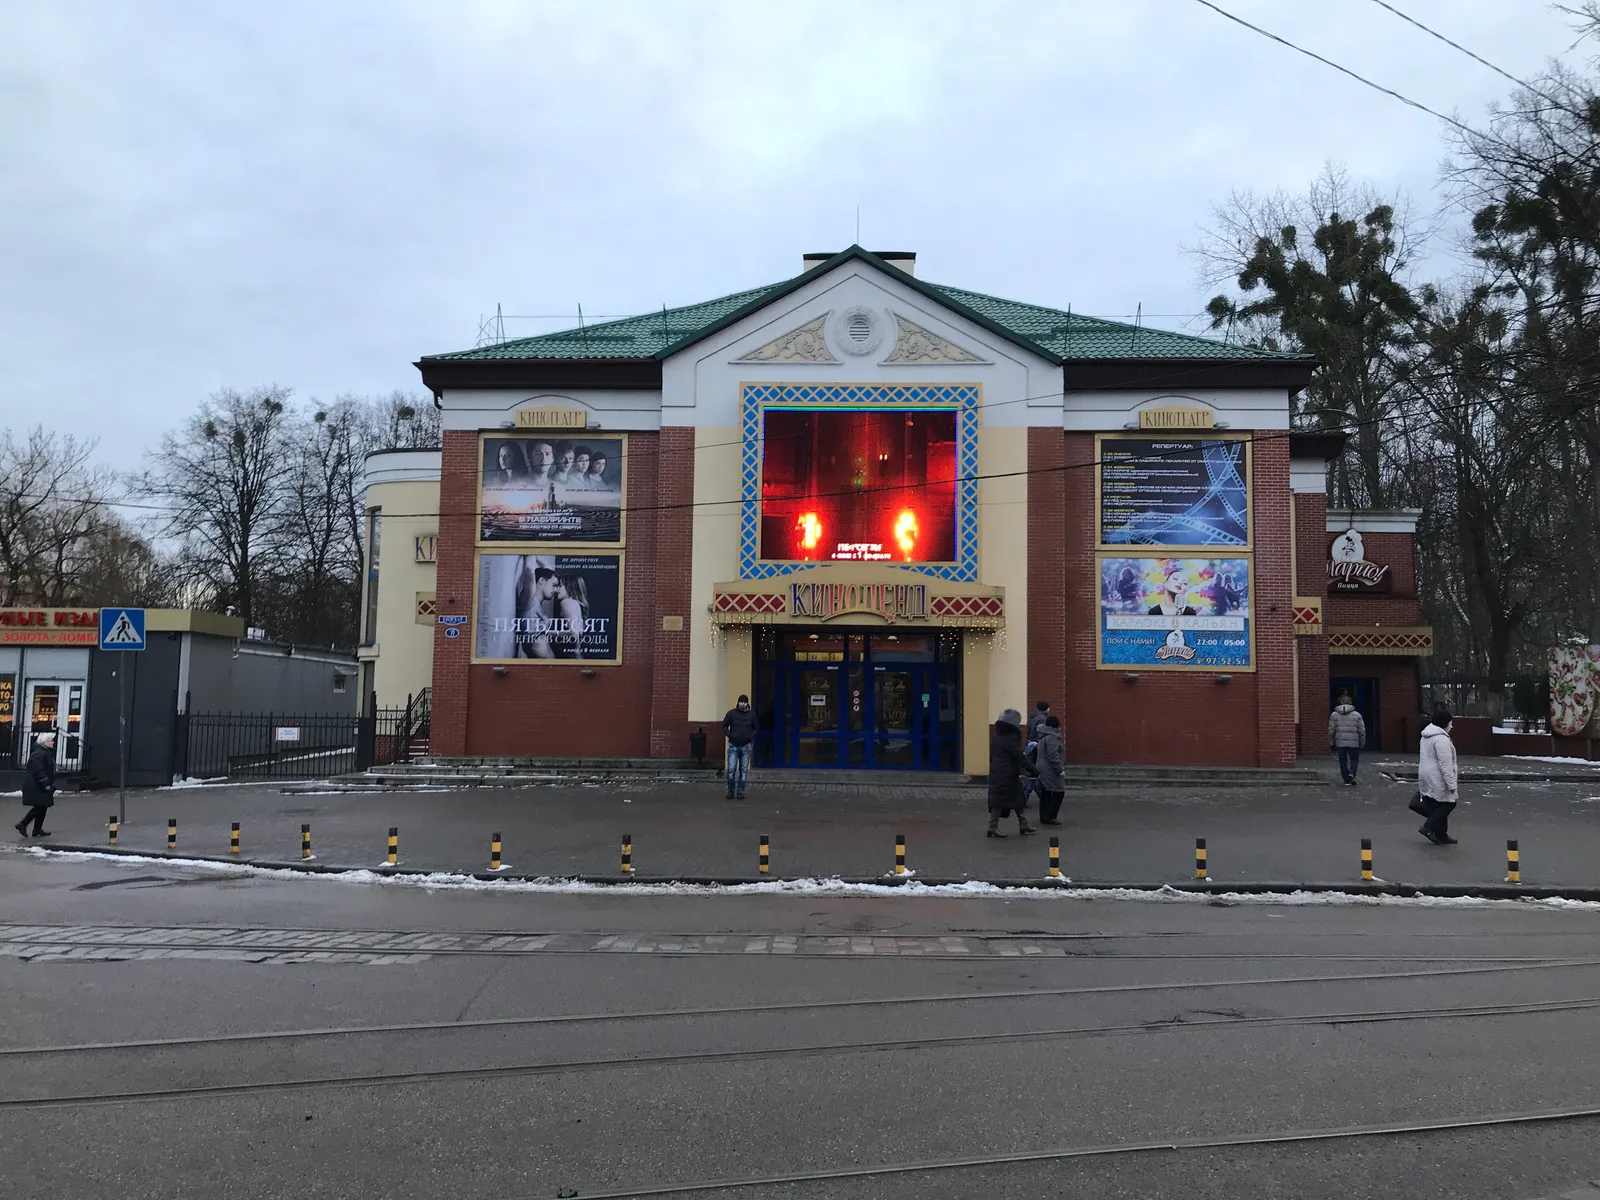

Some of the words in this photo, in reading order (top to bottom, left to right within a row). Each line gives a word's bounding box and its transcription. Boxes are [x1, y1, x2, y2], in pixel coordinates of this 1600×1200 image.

[520, 411, 582, 426] КИНОТЕАТР
[1145, 411, 1210, 427] КИНОТЕАТР
[789, 583, 931, 623] КИНОЛЕНД
[494, 617, 609, 635] ПЯТЬДЕСЯТ
[1112, 617, 1167, 628] КАРАОКЕ
[1184, 618, 1238, 629] КАЛЬЯН
[4, 632, 49, 642] ЗОЛОТА
[493, 634, 553, 644] ОТЕНКОВ
[555, 634, 608, 645] СВОБОДЫ
[1196, 638, 1218, 646] 22:00
